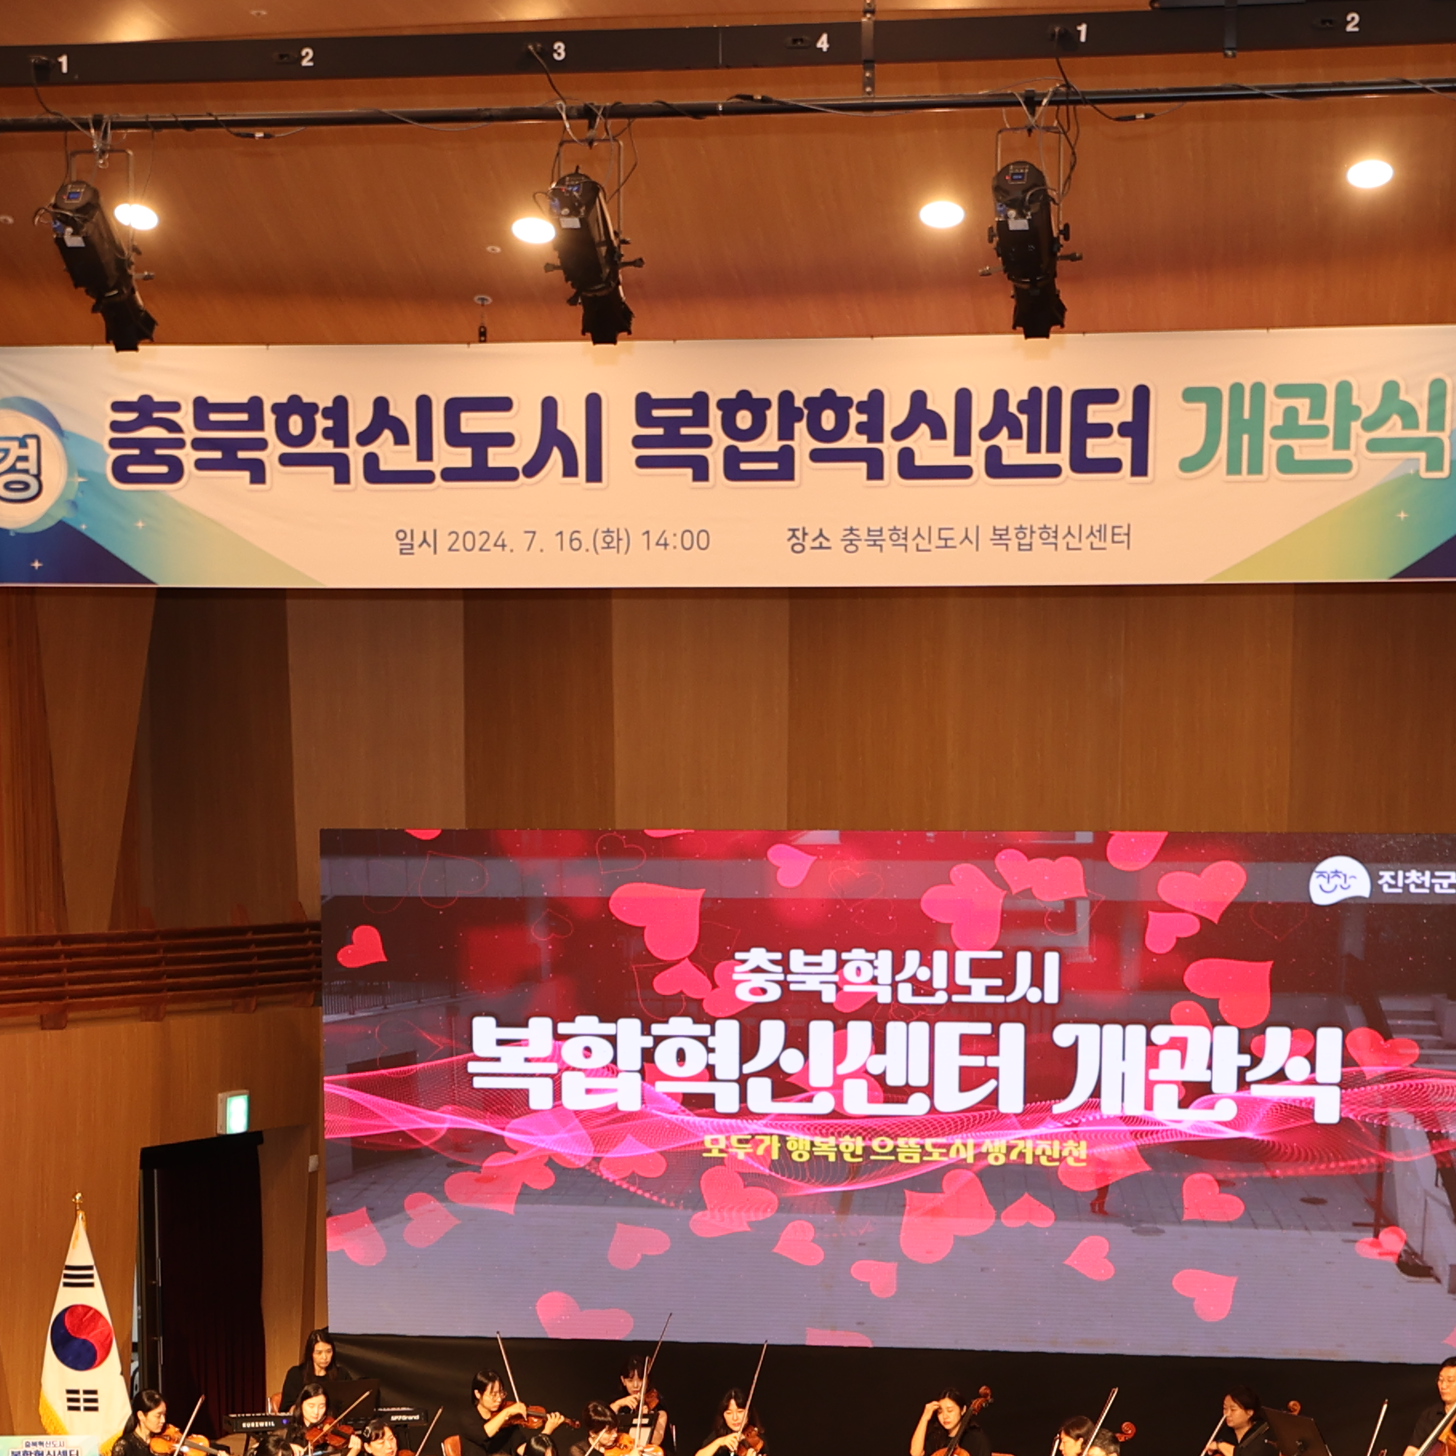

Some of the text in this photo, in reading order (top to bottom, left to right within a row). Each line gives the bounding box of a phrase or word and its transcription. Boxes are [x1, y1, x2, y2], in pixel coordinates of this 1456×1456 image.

[1345, 11, 1360, 32] 2
[815, 32, 830, 52] 4
[1076, 22, 1088, 43] 1
[300, 46, 314, 67] 2
[552, 40, 566, 61] 3
[56, 53, 68, 74] 1
[108, 377, 1449, 486] 충북혁신도시 복합혁신센터 개관식
[394, 523, 1133, 557] 일시 2024. 7. 16.(화) 14:00 장소 충북혁신도시 복합혁신센터
[732, 948, 1061, 1006] 충북혁신도시
[467, 1013, 1343, 1123] 복합혁신센터 개관식
[702, 1135, 1088, 1167] 모두가 행복한 으뜸도시 생거진천
